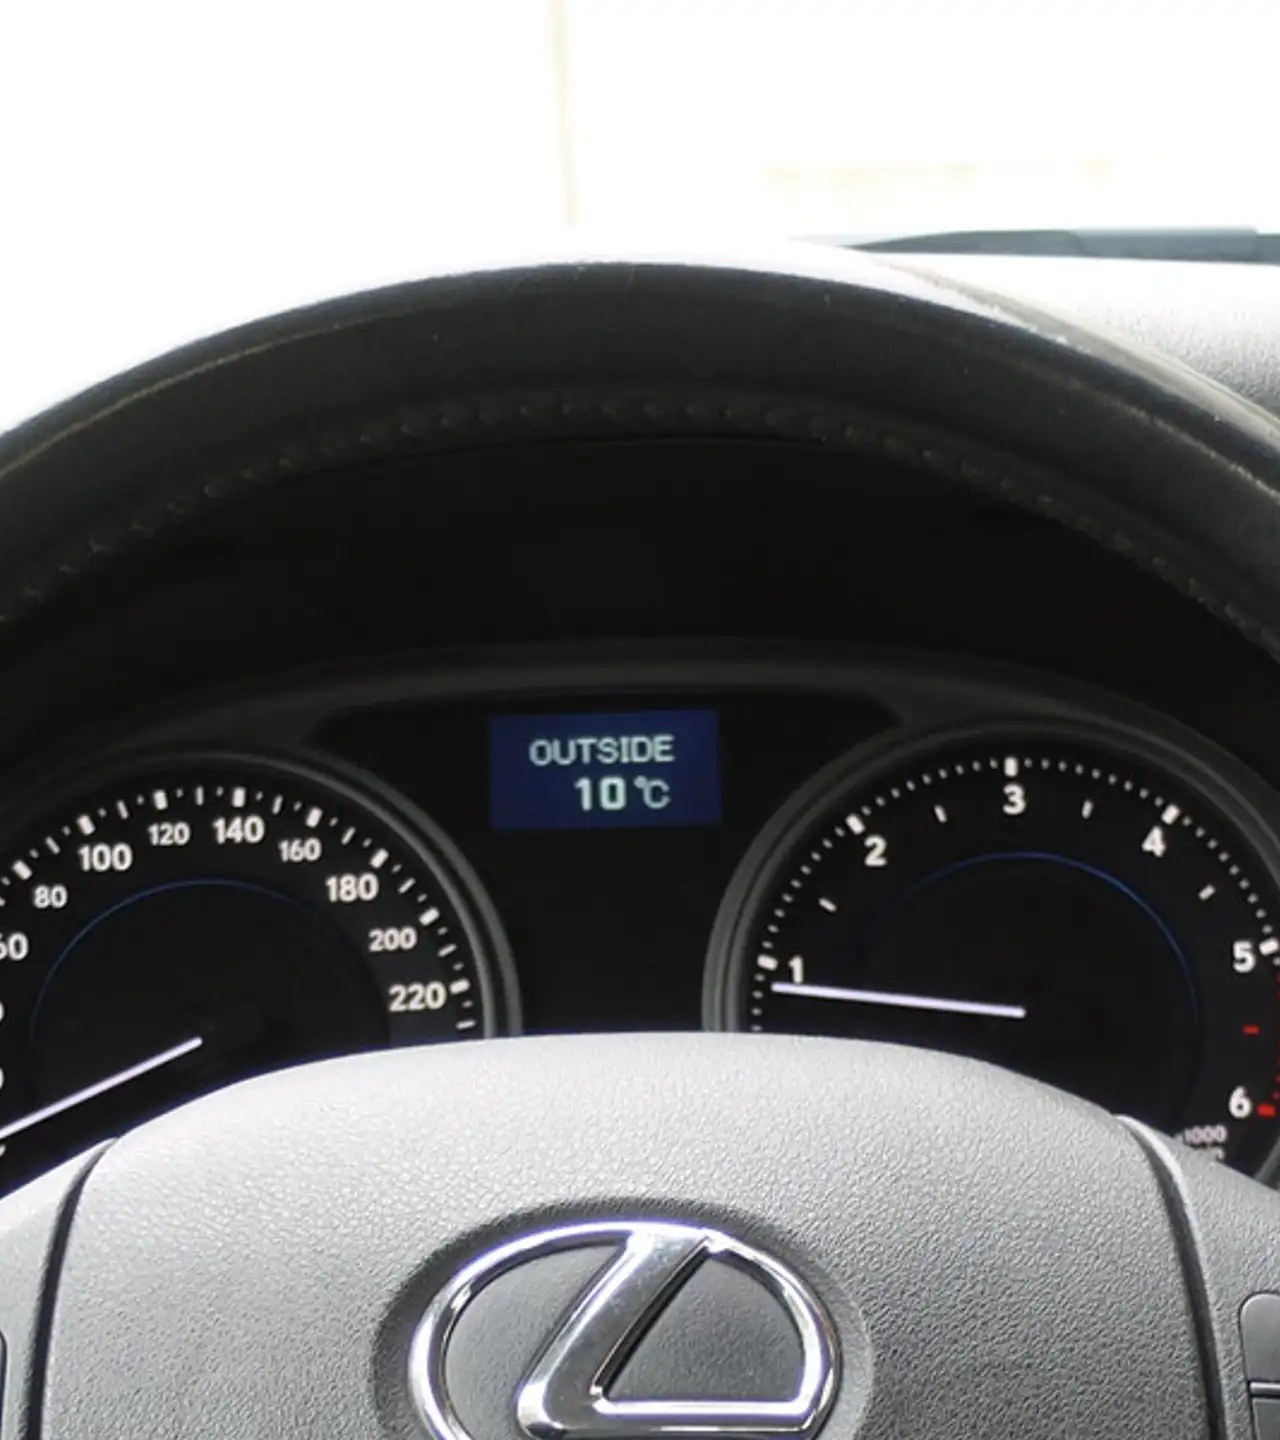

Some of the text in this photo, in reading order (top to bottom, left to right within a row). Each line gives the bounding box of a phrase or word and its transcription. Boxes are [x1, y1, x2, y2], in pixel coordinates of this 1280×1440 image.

[528, 733, 675, 767] OUTSIDE
[1003, 786, 1025, 816] 3
[149, 820, 190, 847] 120
[213, 816, 264, 844] 140
[1142, 829, 1166, 857] 4
[79, 843, 132, 871] 100
[279, 837, 322, 863] 160
[865, 837, 887, 867] 2
[33, 884, 67, 909] 80
[326, 873, 380, 903] 180
[369, 927, 417, 951] 200
[787, 957, 804, 984] 1
[1232, 941, 1255, 972] 5
[388, 981, 447, 1012] 220
[1228, 1087, 1251, 1118] 6
